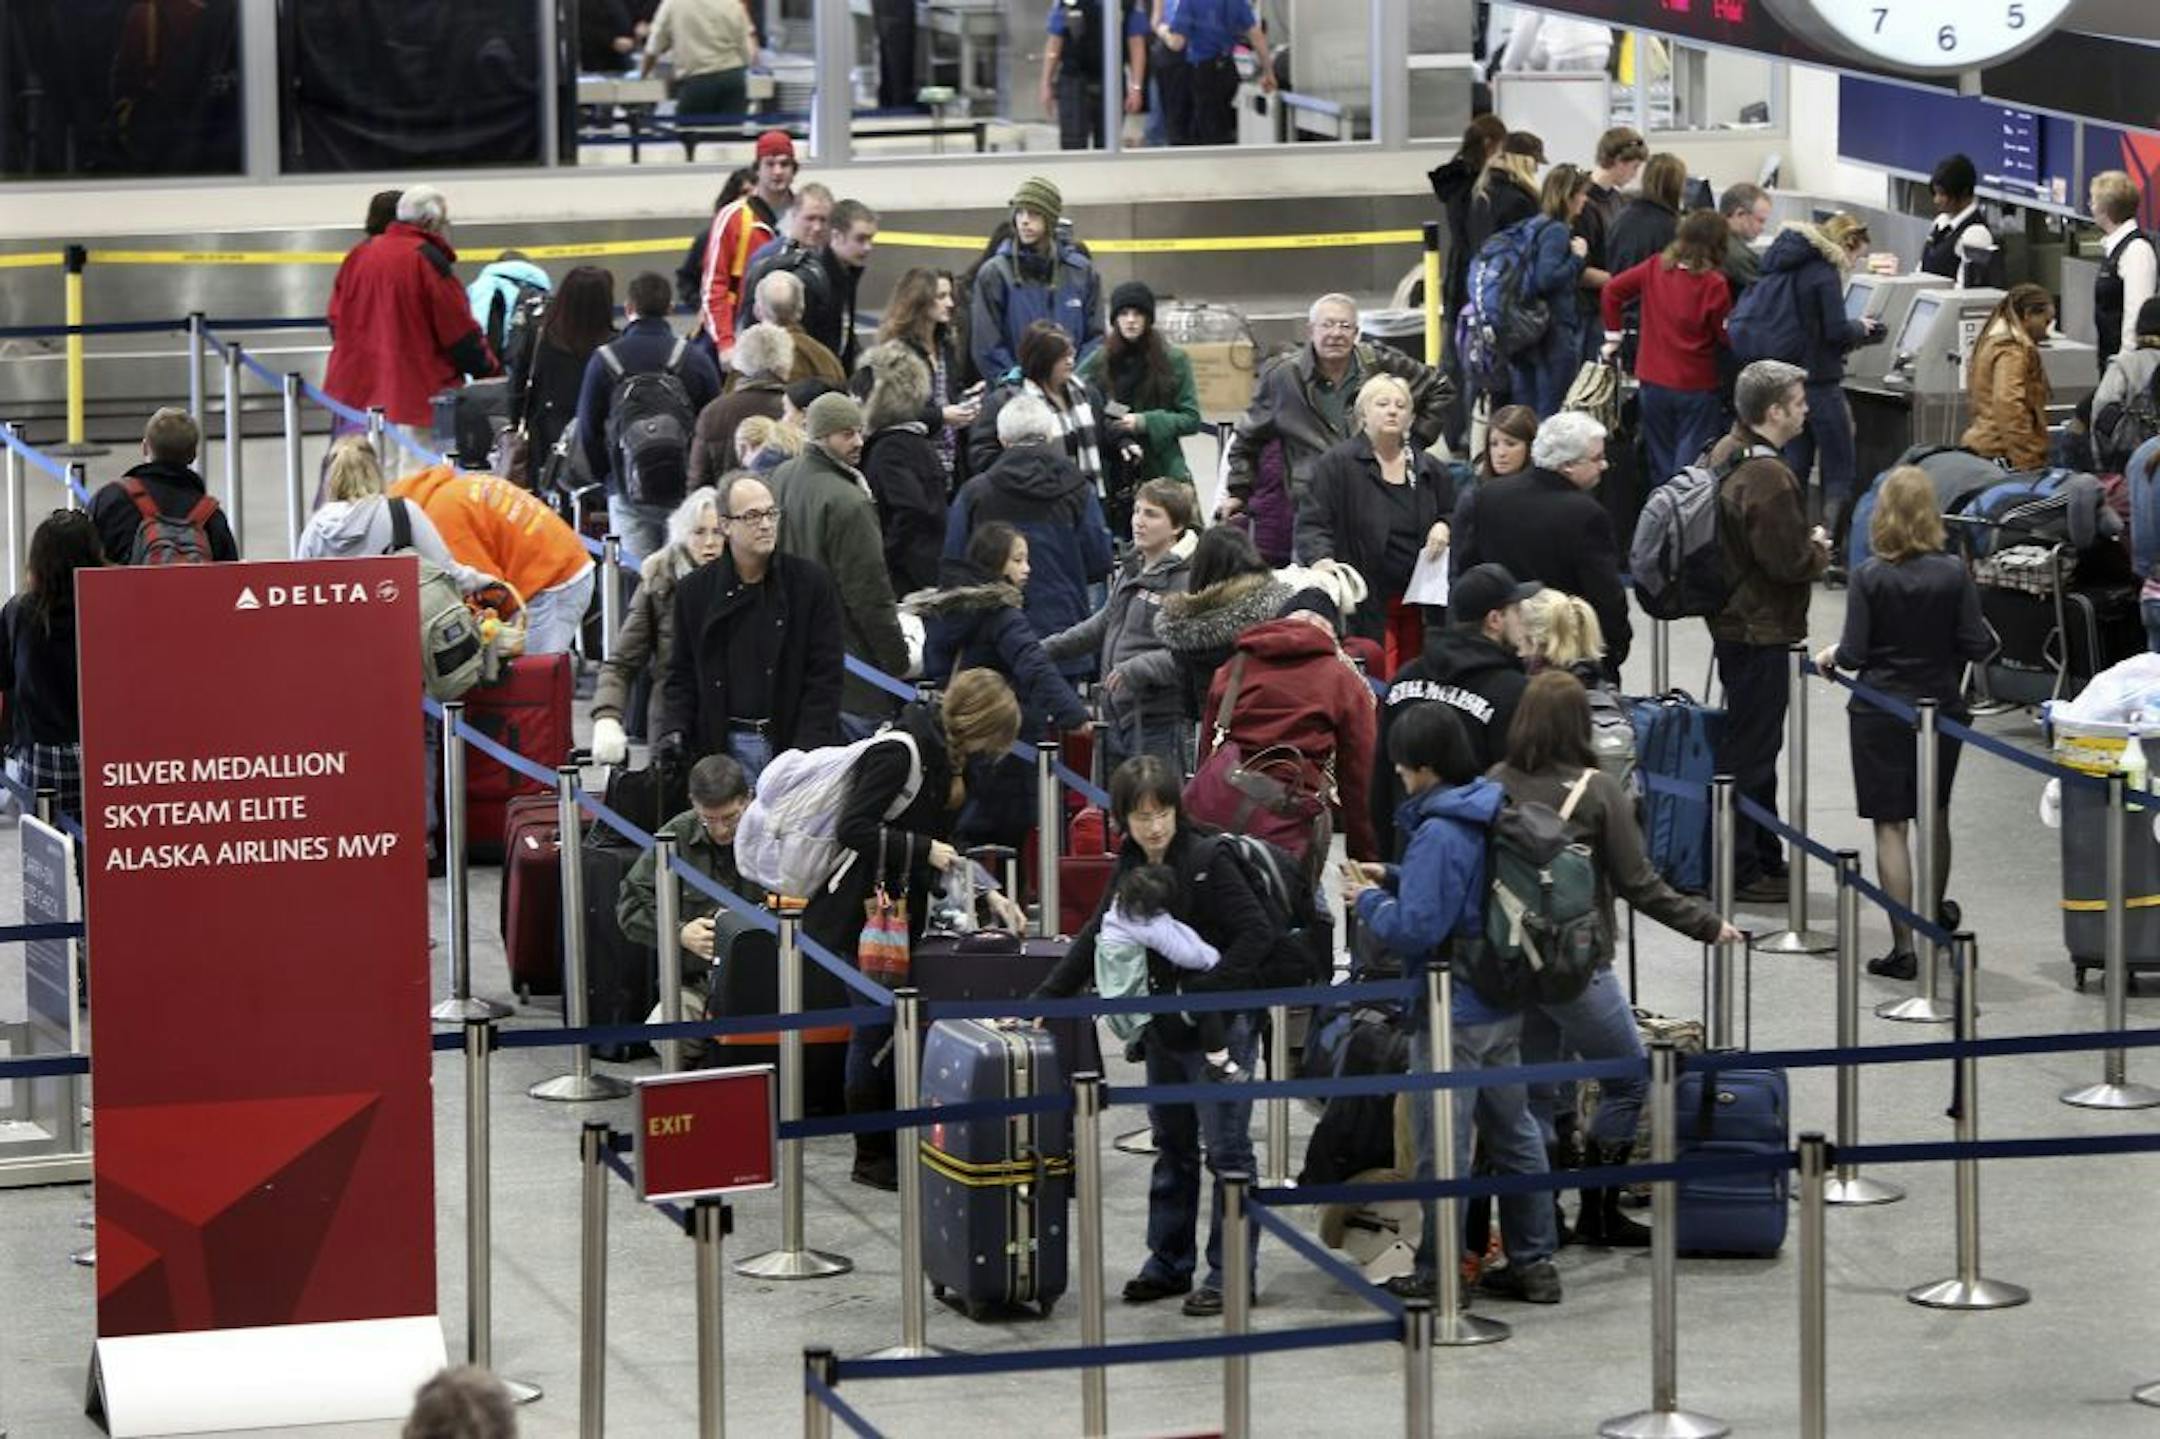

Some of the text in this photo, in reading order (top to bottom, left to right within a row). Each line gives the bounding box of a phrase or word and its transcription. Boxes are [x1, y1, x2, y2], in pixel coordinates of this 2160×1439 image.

[1871, 8, 1889, 35] 7
[2007, 4, 2026, 29] 5
[1937, 25, 1957, 51] 6
[268, 583, 369, 606] DELTA
[102, 752, 346, 787] SILVER MEDALLION
[103, 796, 307, 829] SKYTEAM ELITE
[105, 832, 397, 871] ALASKA AIRLINES MVP
[649, 1114, 694, 1137] EXIT
